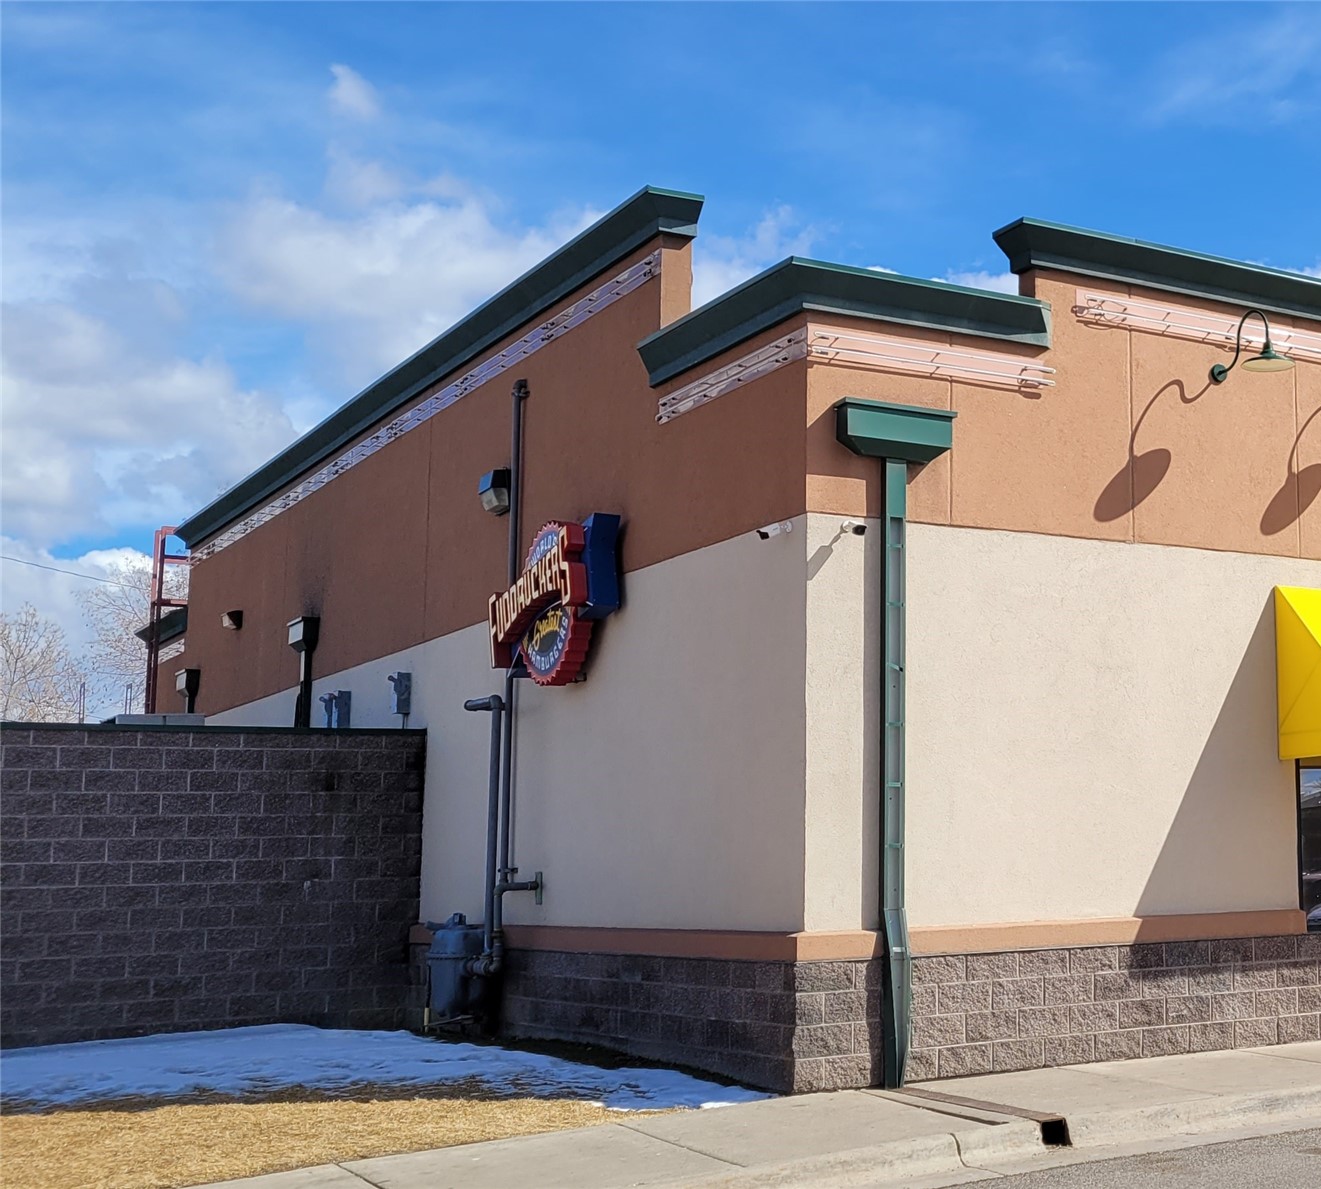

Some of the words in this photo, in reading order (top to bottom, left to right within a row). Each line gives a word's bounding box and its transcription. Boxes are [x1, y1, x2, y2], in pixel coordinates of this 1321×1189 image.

[488, 525, 571, 668] FUDDRUCKERS
[527, 616, 569, 671] HAMBURGERS
[531, 607, 563, 651] Greatest
